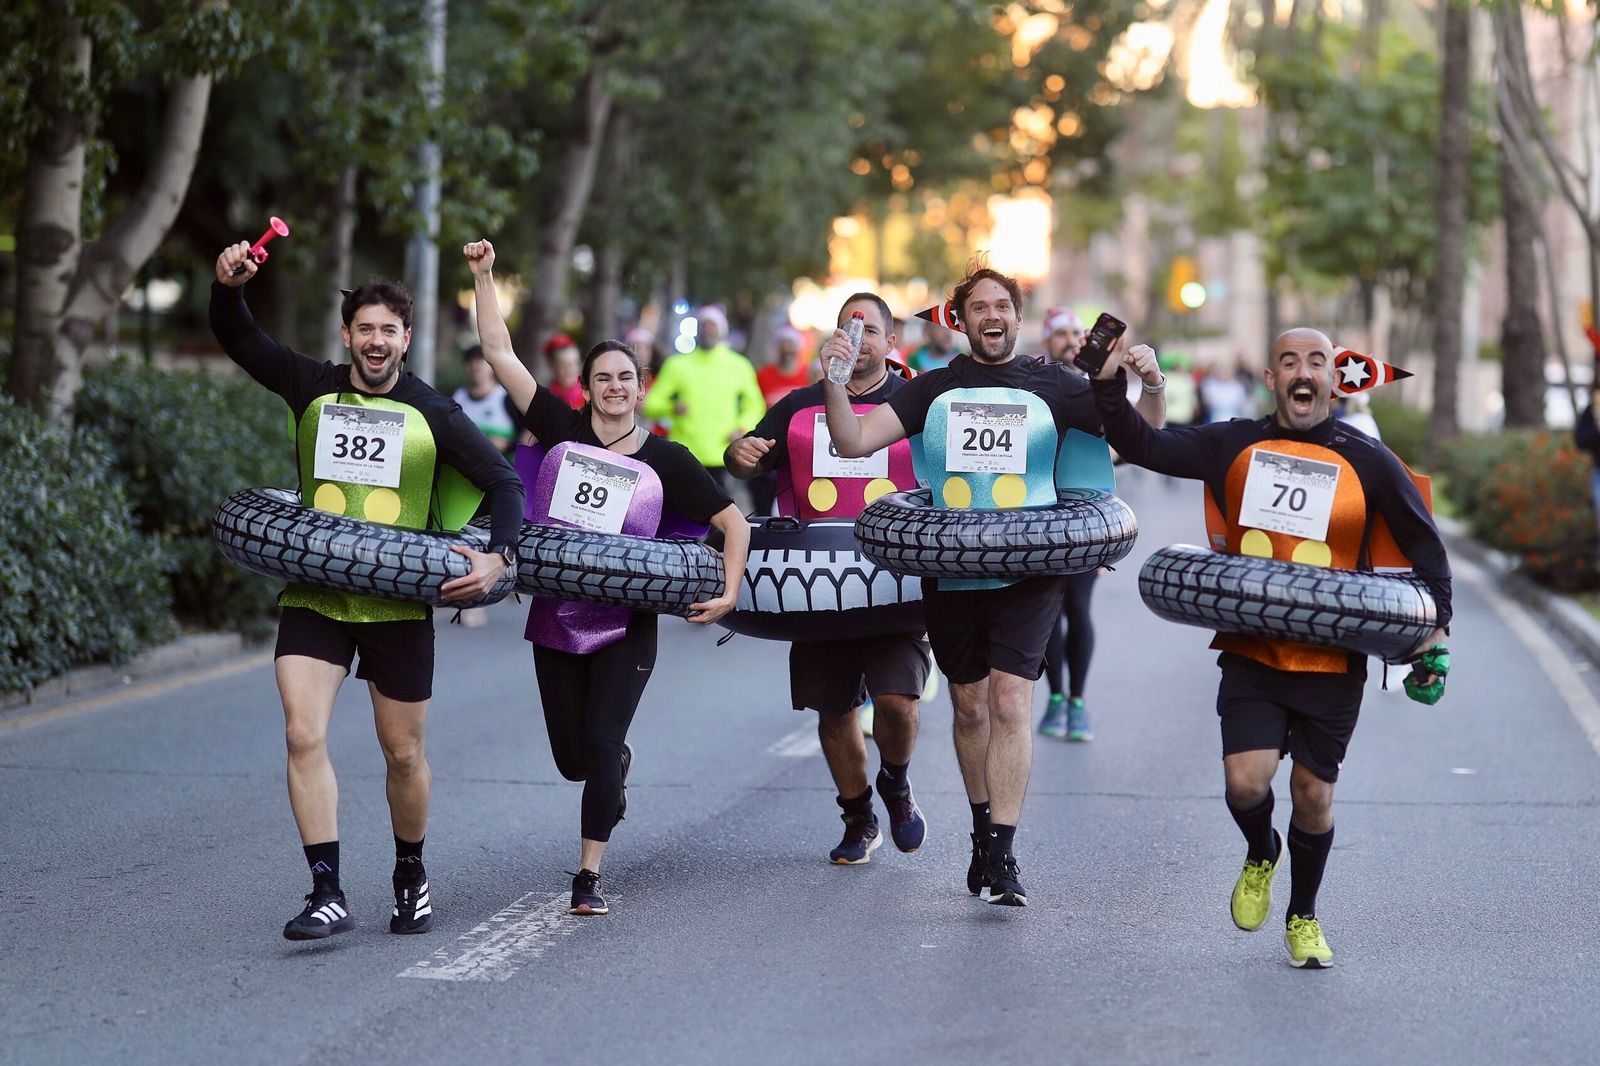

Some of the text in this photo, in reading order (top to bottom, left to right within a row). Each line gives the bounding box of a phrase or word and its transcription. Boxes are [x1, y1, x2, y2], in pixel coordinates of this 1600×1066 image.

[332, 433, 386, 463] 382
[962, 428, 1013, 452] 204
[574, 481, 608, 509] 89
[1272, 483, 1307, 512] 70
